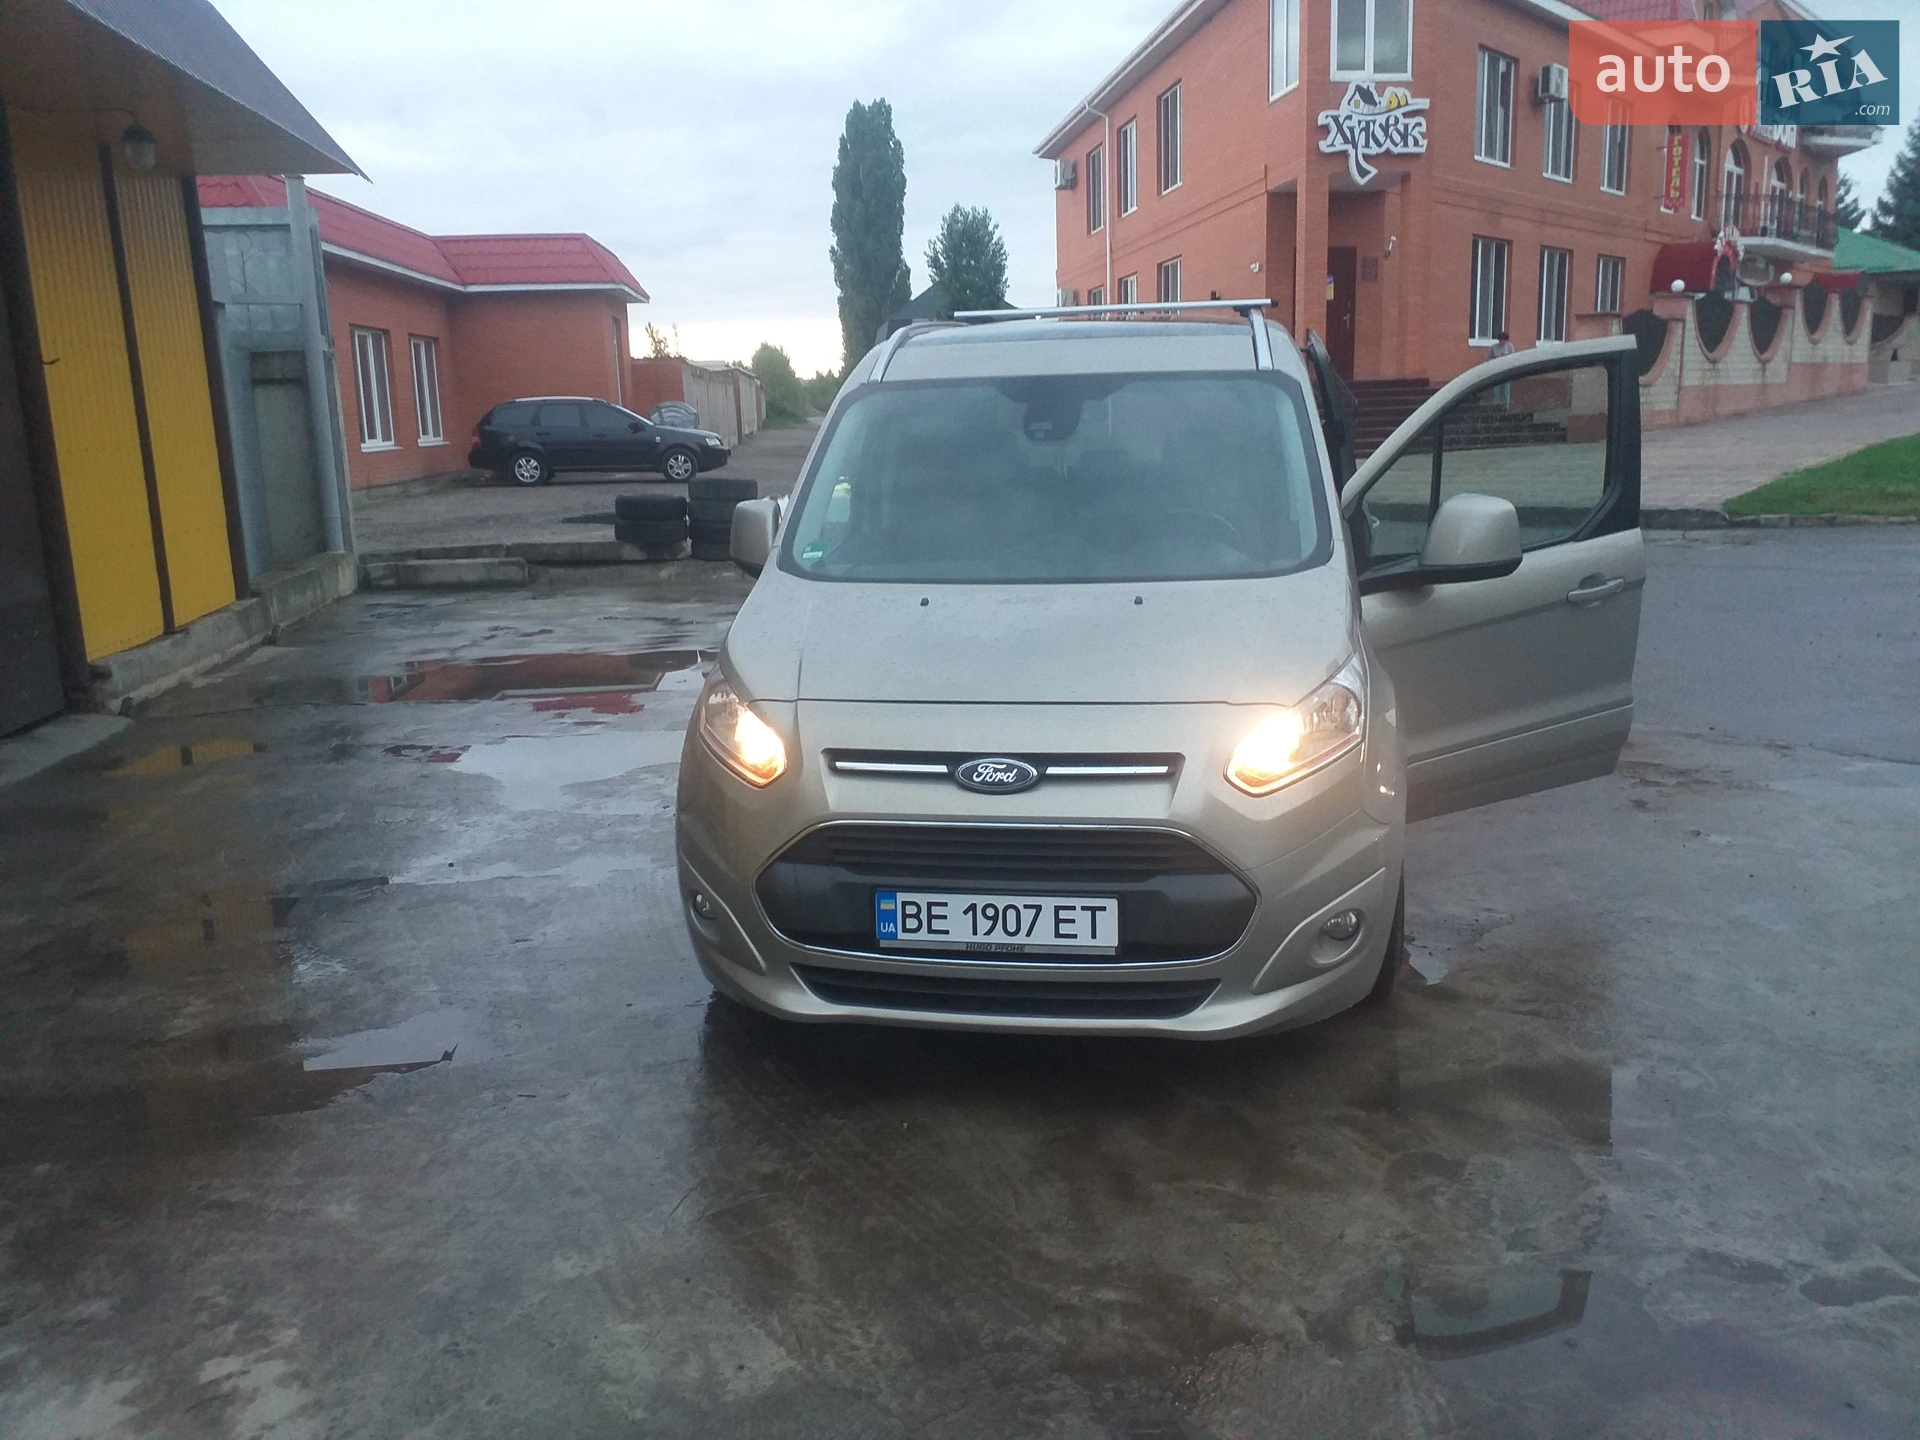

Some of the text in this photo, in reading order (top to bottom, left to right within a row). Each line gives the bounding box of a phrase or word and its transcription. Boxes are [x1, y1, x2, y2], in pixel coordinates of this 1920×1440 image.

[972, 763, 1018, 783] Ford
[880, 922, 896, 933] UA
[901, 900, 1107, 940] BE 1907 ET
